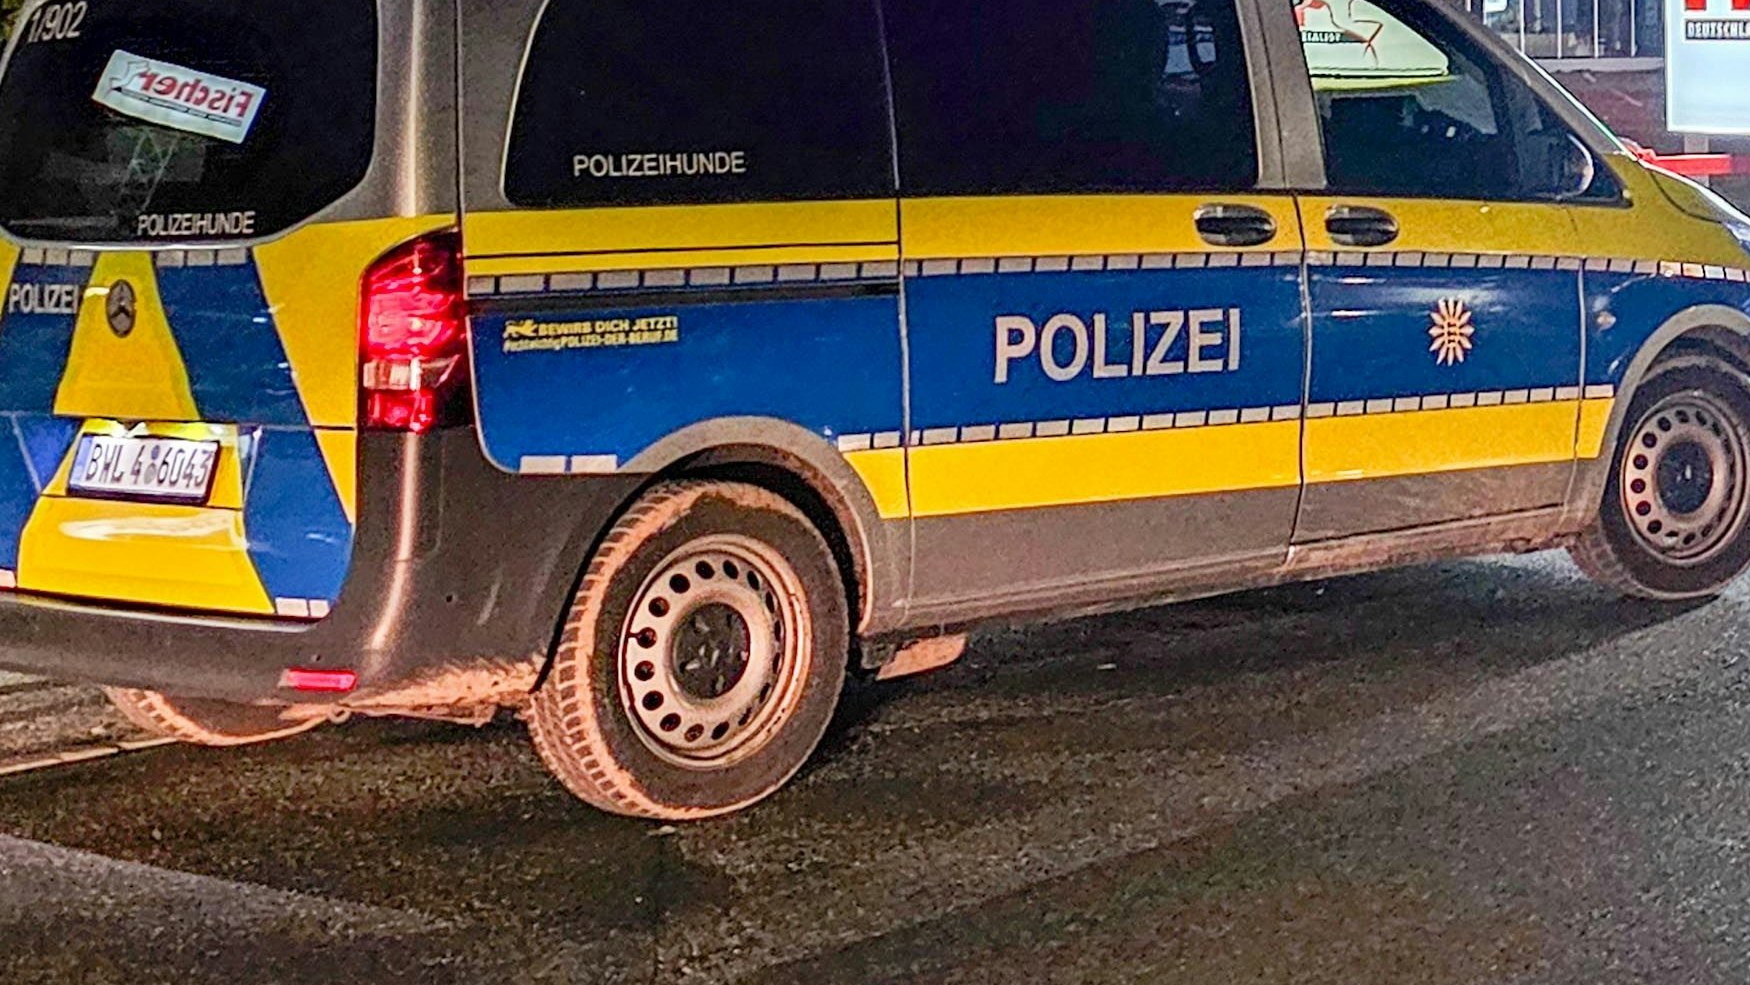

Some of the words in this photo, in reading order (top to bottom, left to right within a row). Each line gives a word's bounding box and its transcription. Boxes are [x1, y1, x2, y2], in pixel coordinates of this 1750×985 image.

[27, 1, 87, 43] 1/902
[573, 151, 747, 177] POLIZEIHUNDE
[137, 211, 256, 236] POLIZEIHUNDE
[8, 283, 79, 314] POLIZEI
[594, 319, 630, 333] DICH
[993, 307, 1240, 384] POLIZEI
